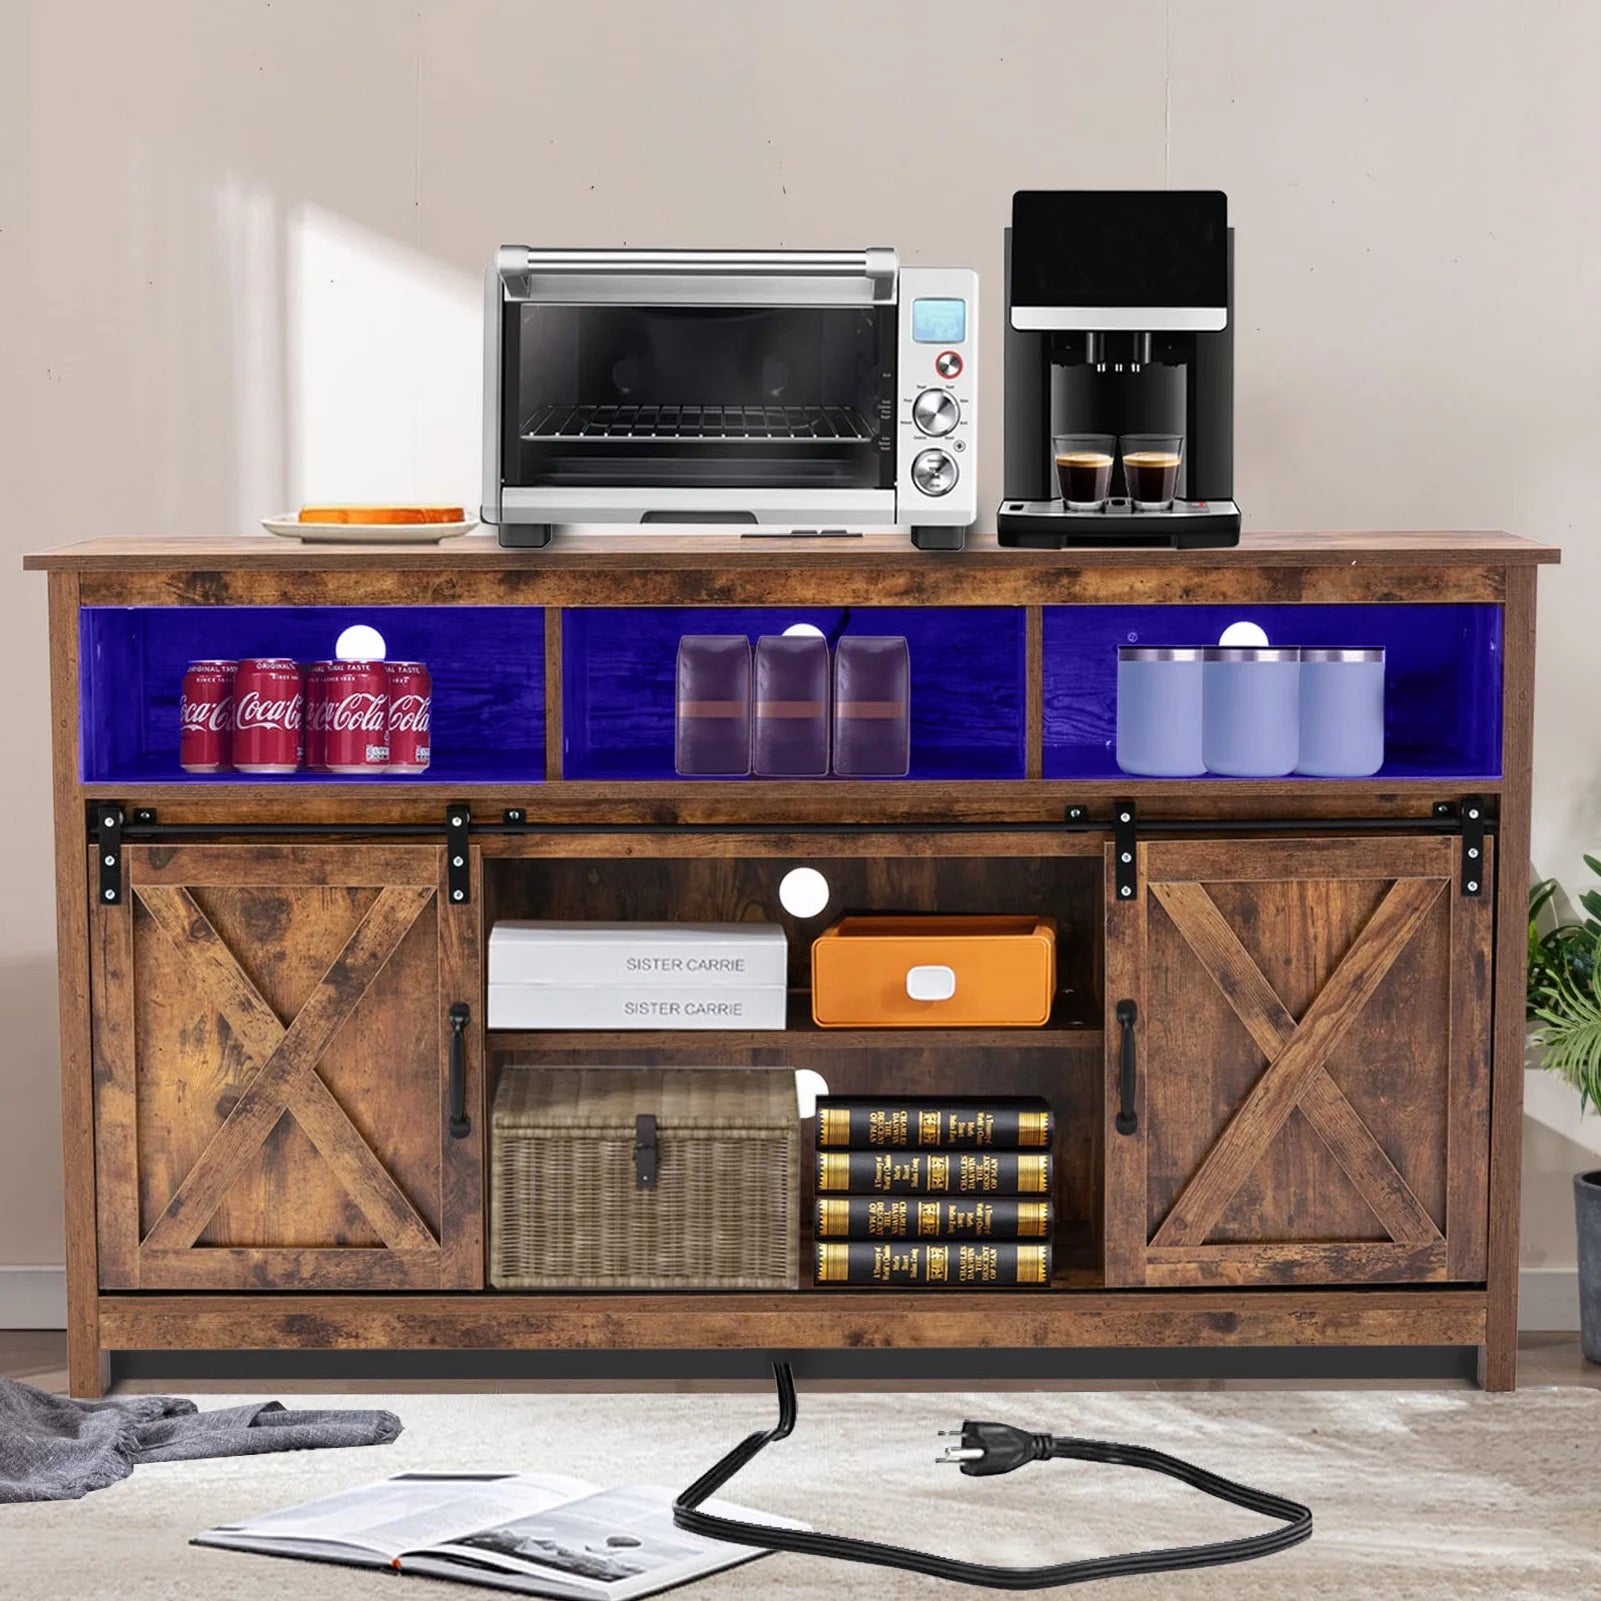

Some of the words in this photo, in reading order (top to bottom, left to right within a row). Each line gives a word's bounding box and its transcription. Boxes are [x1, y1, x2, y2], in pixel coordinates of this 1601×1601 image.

[626, 958, 683, 972] SISTER
[686, 958, 745, 972] CARRIE
[624, 1002, 681, 1016] SISTER
[684, 1002, 743, 1016] CARRIE
[960, 1155, 968, 1191] CHARLES
[991, 1177, 998, 1188] OF
[967, 1247, 975, 1279] DARWIN
[990, 1269, 997, 1279] OF
